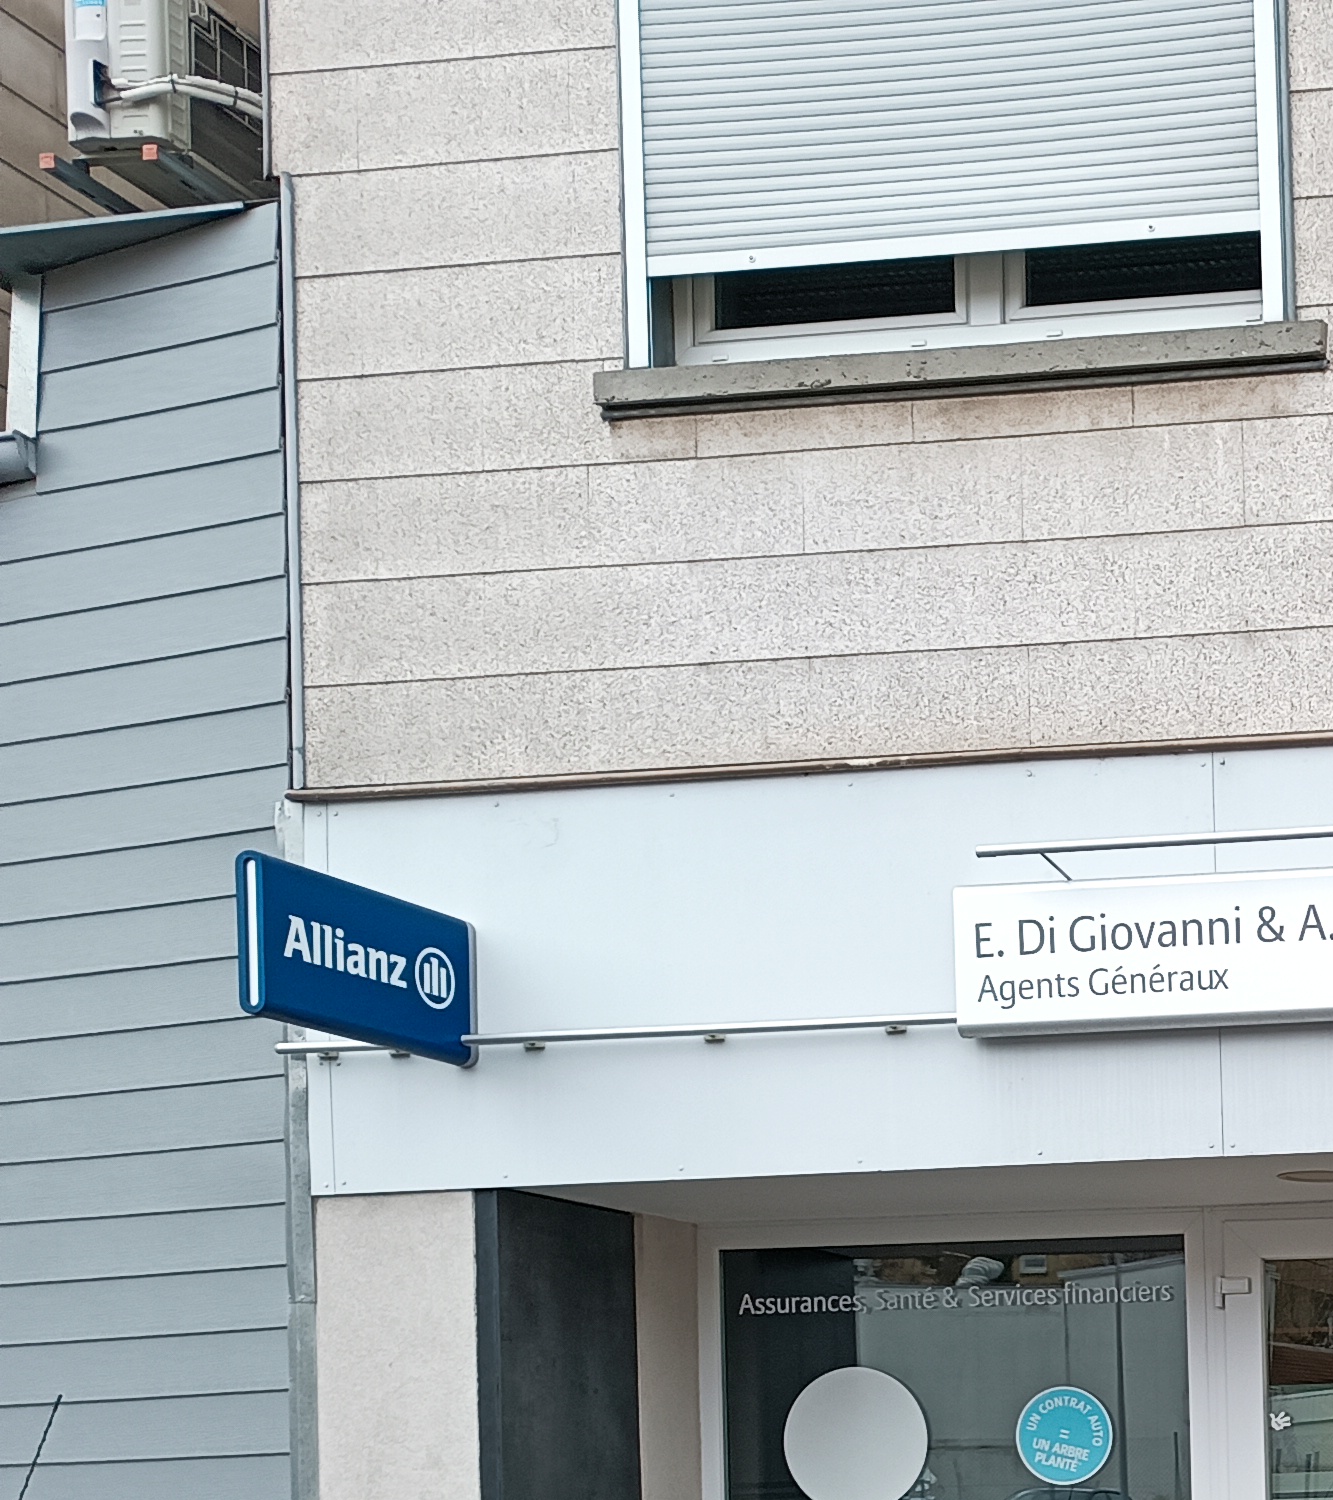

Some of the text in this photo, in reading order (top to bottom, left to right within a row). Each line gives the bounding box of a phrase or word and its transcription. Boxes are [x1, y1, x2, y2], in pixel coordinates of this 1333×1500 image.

[283, 914, 408, 989] Allianz
[974, 922, 1006, 959] E.
[1018, 915, 1057, 956] Di
[1069, 905, 1242, 953] Giovanni
[1256, 905, 1287, 943] &
[977, 963, 1230, 1009] Agents Généraux
[739, 1280, 1174, 1316] Assurances, Santé & Services financiers
[1026, 1396, 1104, 1447] UN CONTRAT AUTO
[1032, 1437, 1090, 1462] UN ARBRE
